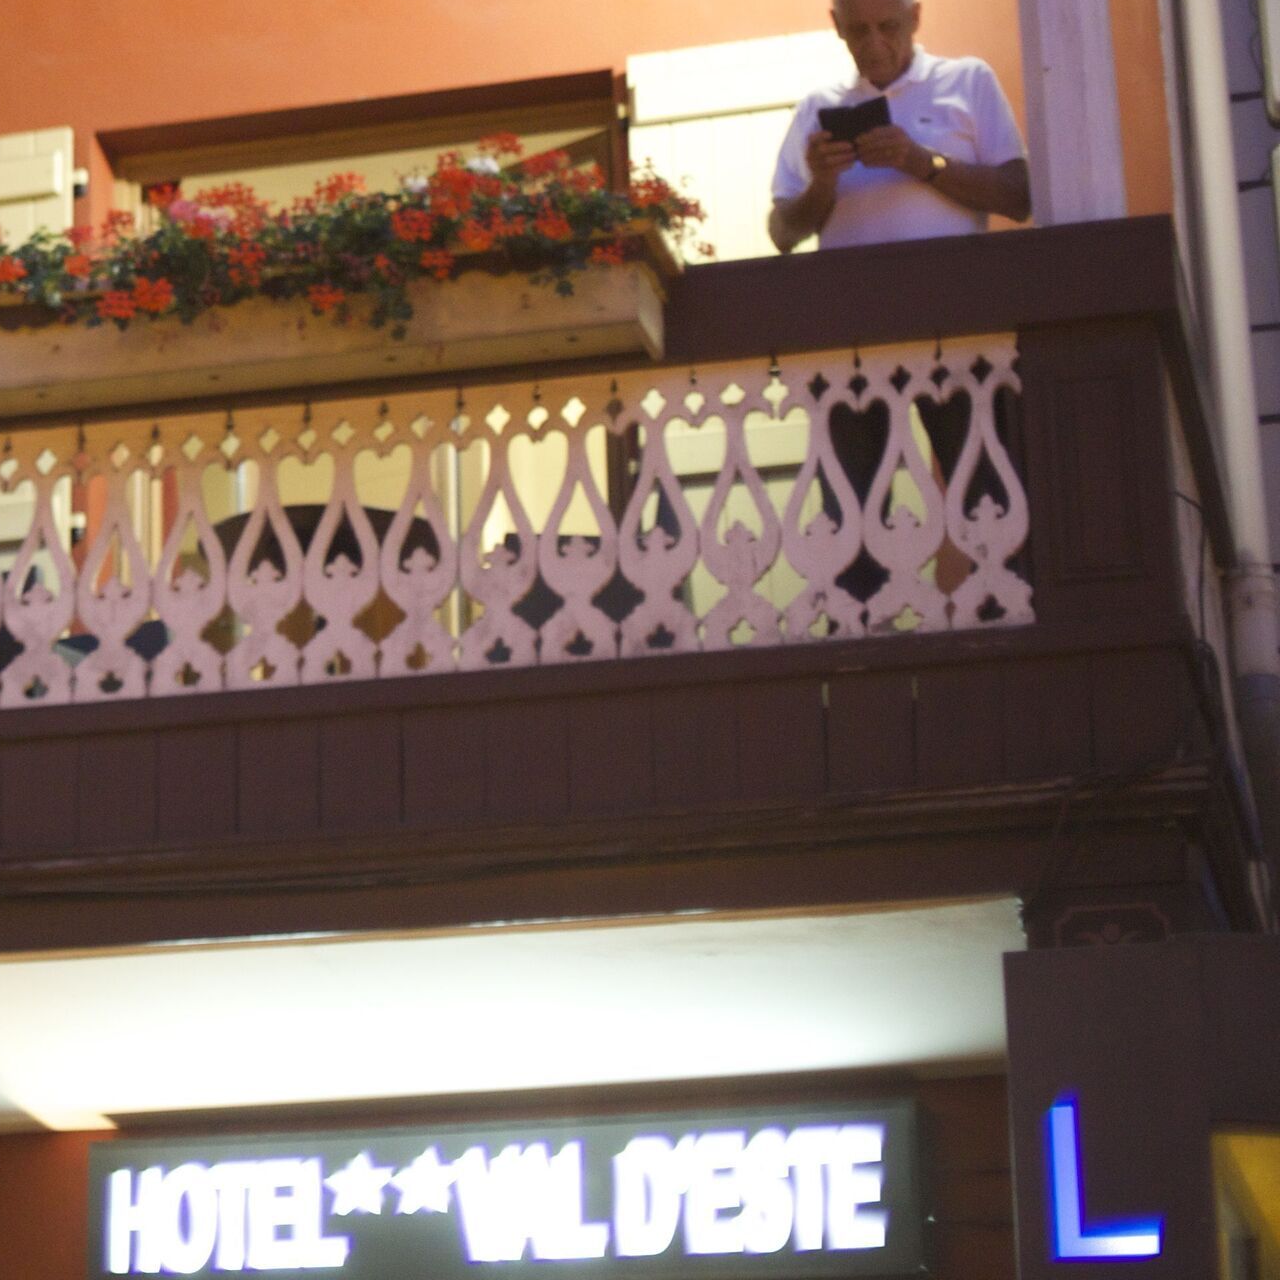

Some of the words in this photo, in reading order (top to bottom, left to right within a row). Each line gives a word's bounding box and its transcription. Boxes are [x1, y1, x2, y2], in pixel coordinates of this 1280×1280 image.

[108, 1157, 350, 1275] HOTEL
[456, 1140, 609, 1263] VAL
[614, 1125, 888, 1256] D'ESTE
[1049, 1099, 1162, 1259] L
